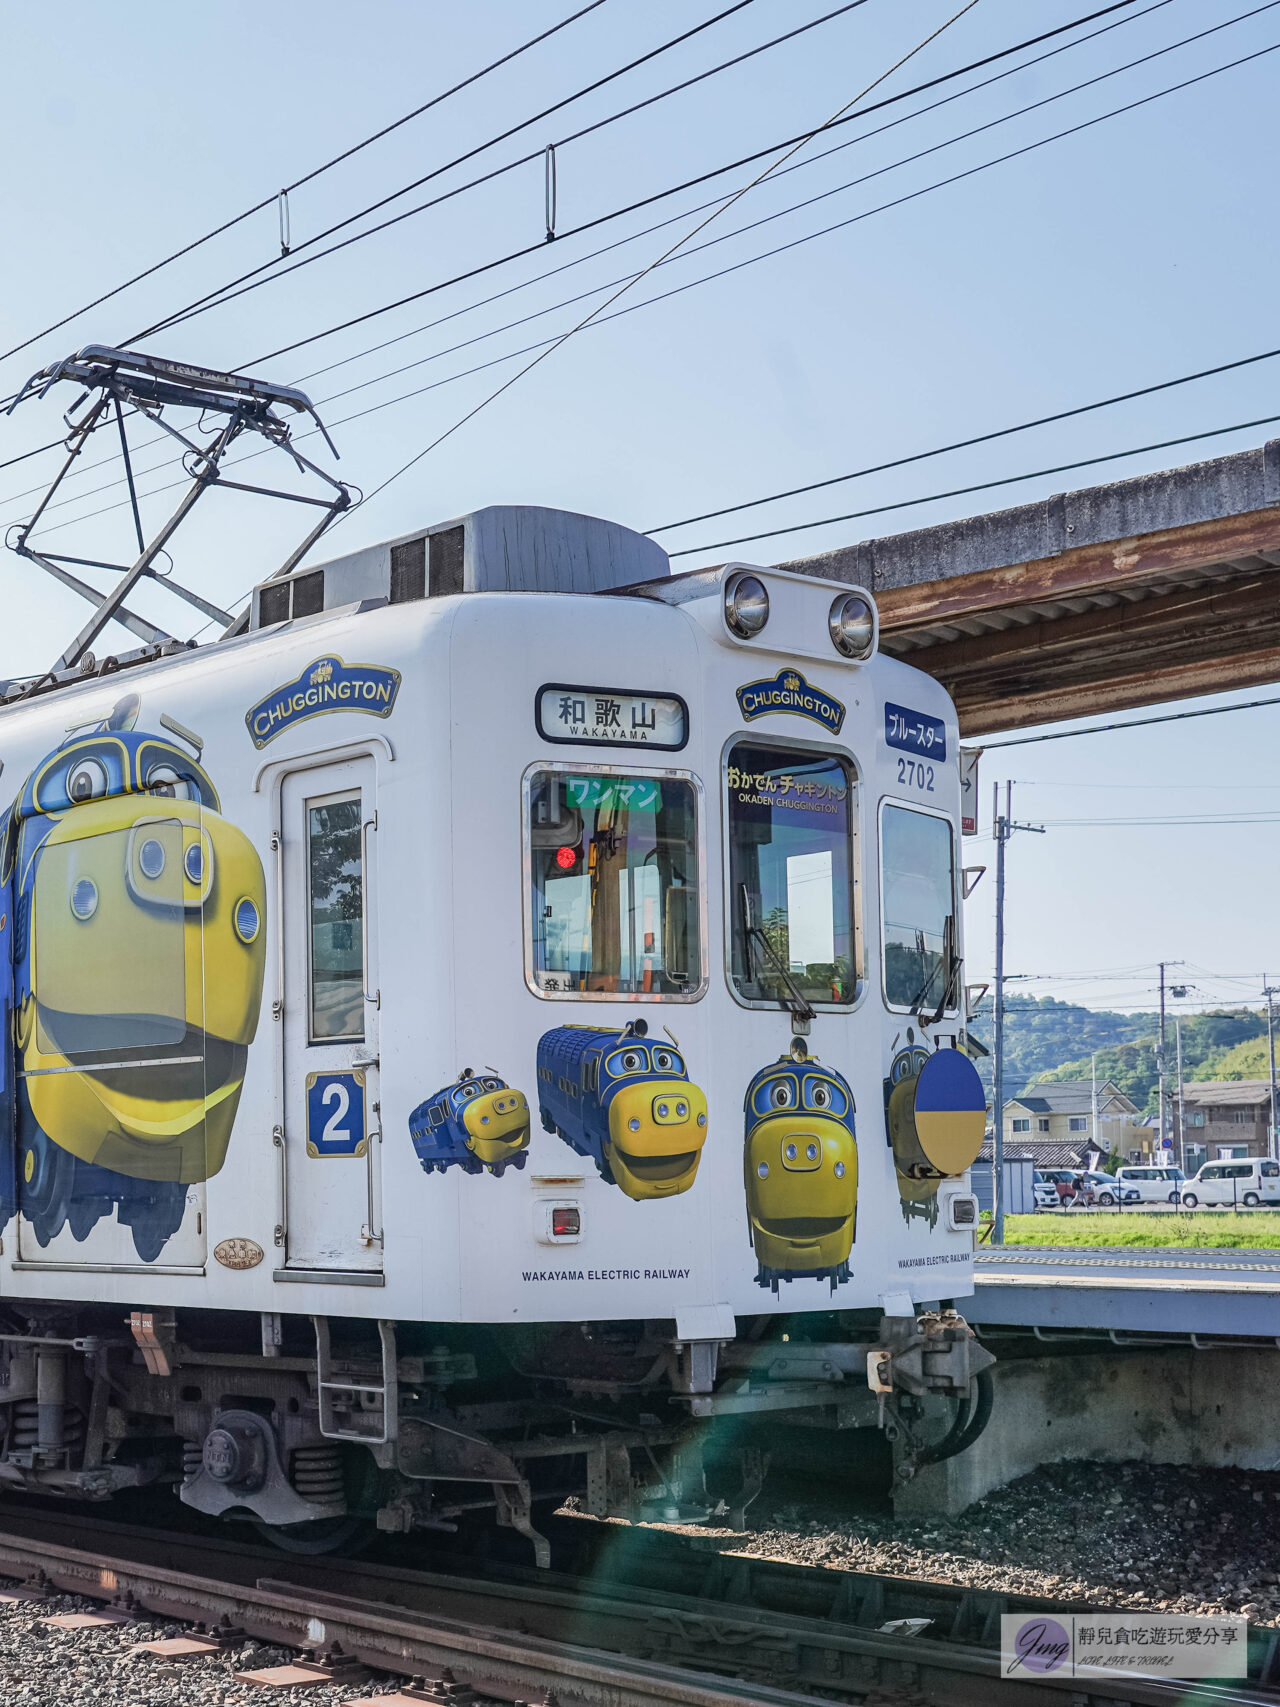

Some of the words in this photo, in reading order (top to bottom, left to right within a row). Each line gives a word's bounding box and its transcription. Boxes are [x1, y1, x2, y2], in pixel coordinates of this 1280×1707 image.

[254, 681, 392, 736] CHUGGINGTON
[558, 696, 656, 730] 和歌山
[742, 691, 840, 724] CHUGGINGTON
[570, 726, 648, 741] WAKAYAMA
[888, 713, 944, 748] ブルースター
[728, 766, 777, 793] おかでん
[897, 757, 935, 792] 2702
[570, 779, 658, 808] ワンマン
[738, 793, 774, 806] OKADEN
[776, 798, 838, 814] CHUGGINGTON
[322, 1082, 350, 1142] 2
[522, 1270, 585, 1281] WAKAYAMA
[587, 1270, 641, 1280] ELECTRIC
[644, 1269, 691, 1279] RAILWAY
[898, 1258, 926, 1269] WAKAYAMA
[926, 1255, 950, 1266] ELECTRIC
[950, 1253, 971, 1262] RAILWAY
